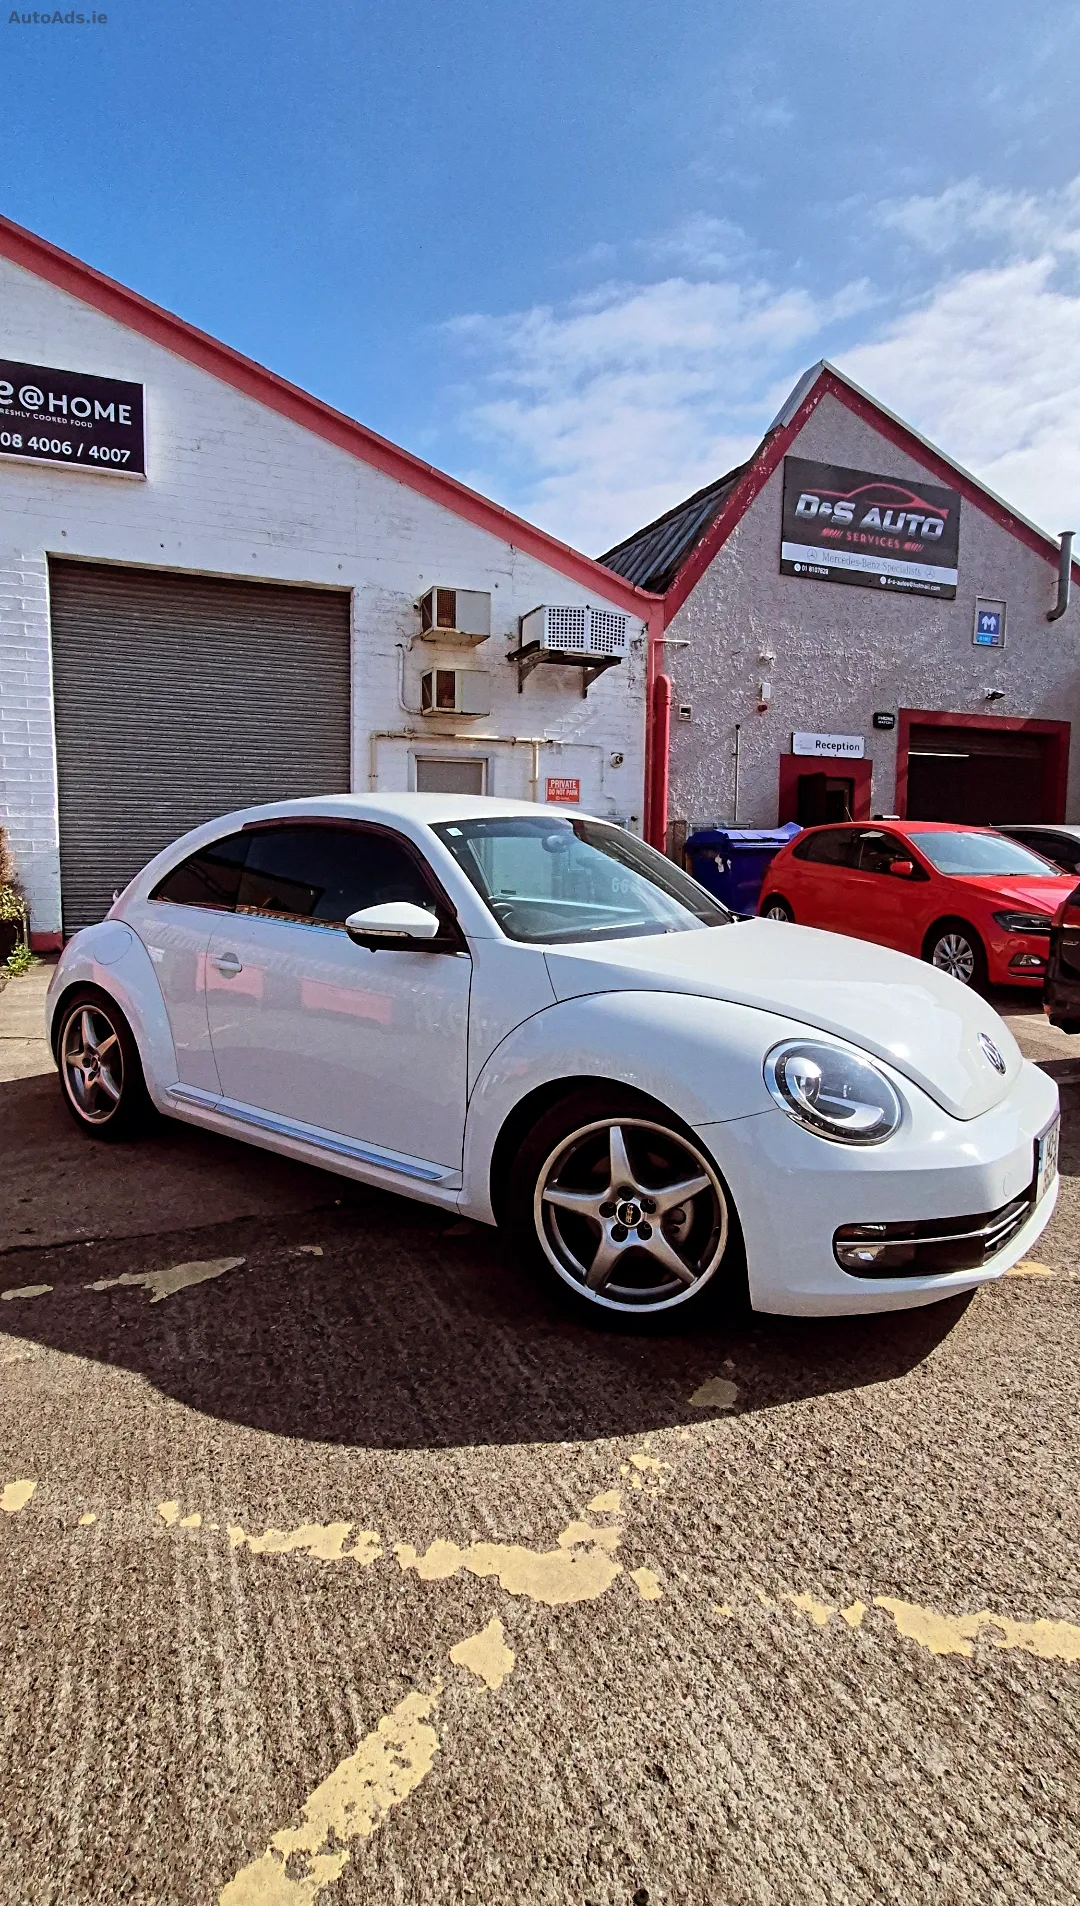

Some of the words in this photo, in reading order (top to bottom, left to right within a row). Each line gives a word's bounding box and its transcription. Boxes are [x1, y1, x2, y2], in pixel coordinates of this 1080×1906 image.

[32, 413, 68, 424] COOKED
[70, 419, 93, 429] FOOD
[27, 436, 73, 455] 4006
[88, 445, 131, 463] 4007
[795, 493, 856, 526] D&S
[859, 507, 945, 541] AUTO
[845, 532, 901, 549] SERVICES
[822, 551, 881, 569] Mercedes-Benz
[882, 562, 922, 578] Specialists
[815, 739, 860, 752] Reception
[550, 779, 577, 789] PRIVATE
[555, 788, 565, 796] NOT
